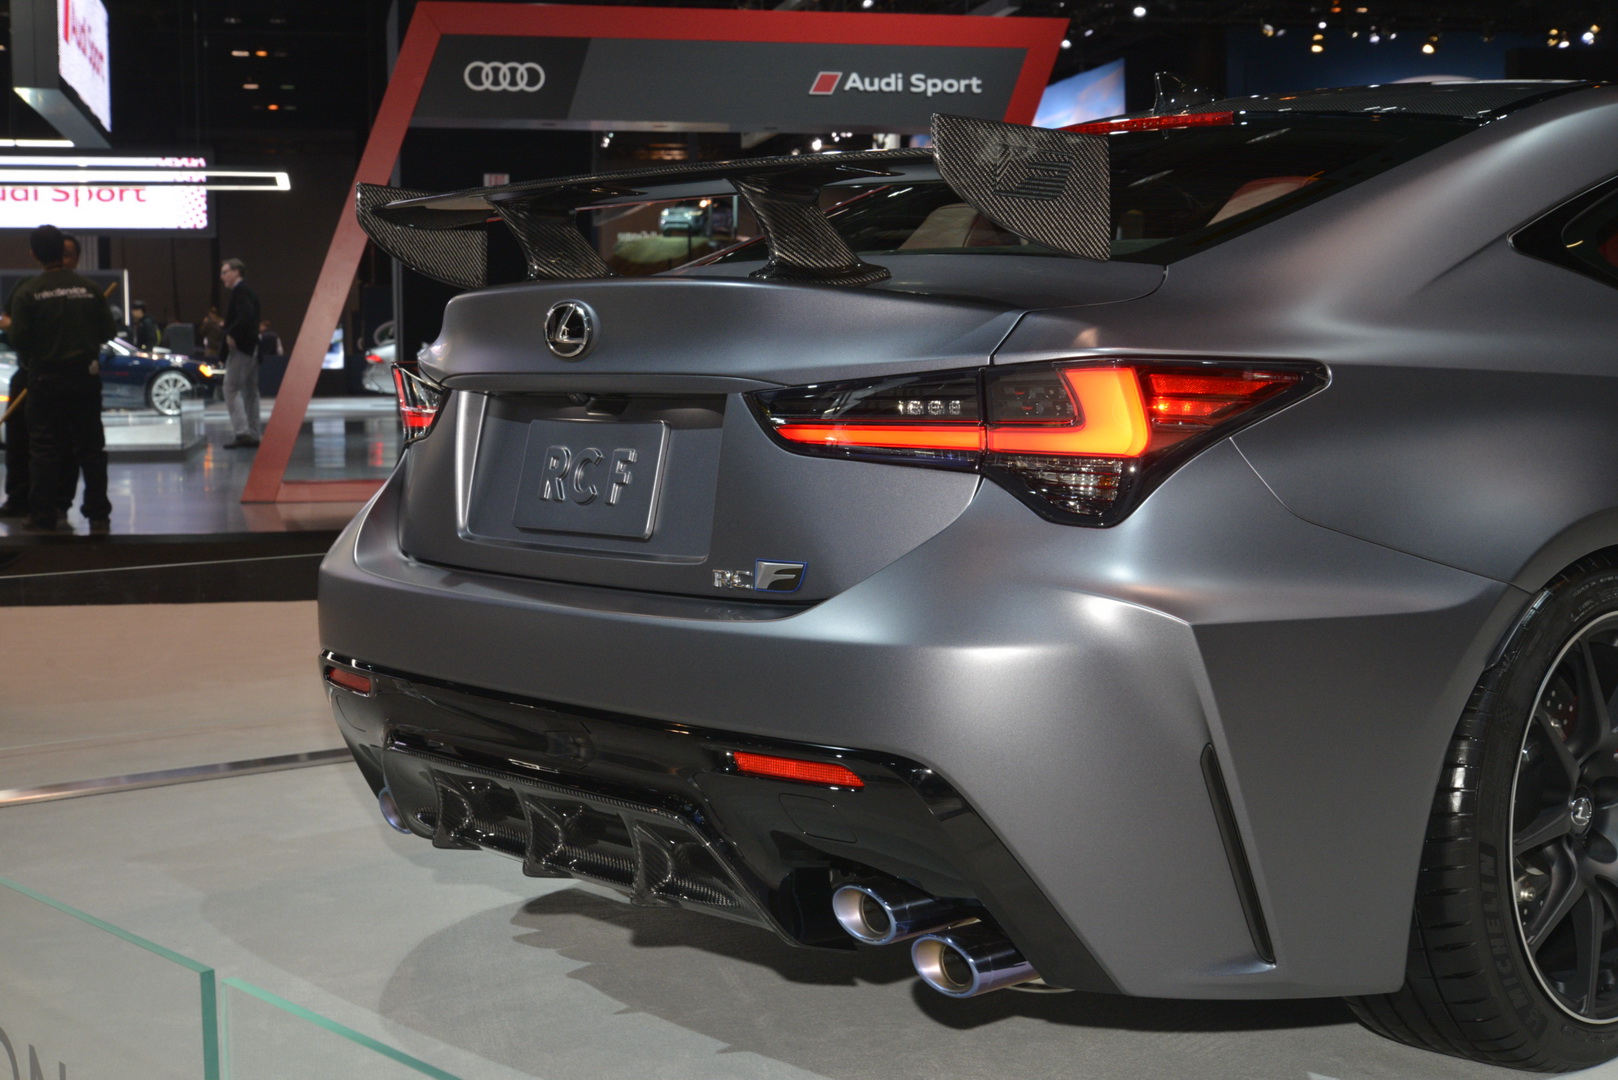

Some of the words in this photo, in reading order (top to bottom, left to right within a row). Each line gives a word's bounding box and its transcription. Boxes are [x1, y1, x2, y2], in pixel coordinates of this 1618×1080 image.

[843, 72, 903, 92] Audi
[909, 73, 982, 97] Sport
[1479, 852, 1531, 1012] MICHELIN
